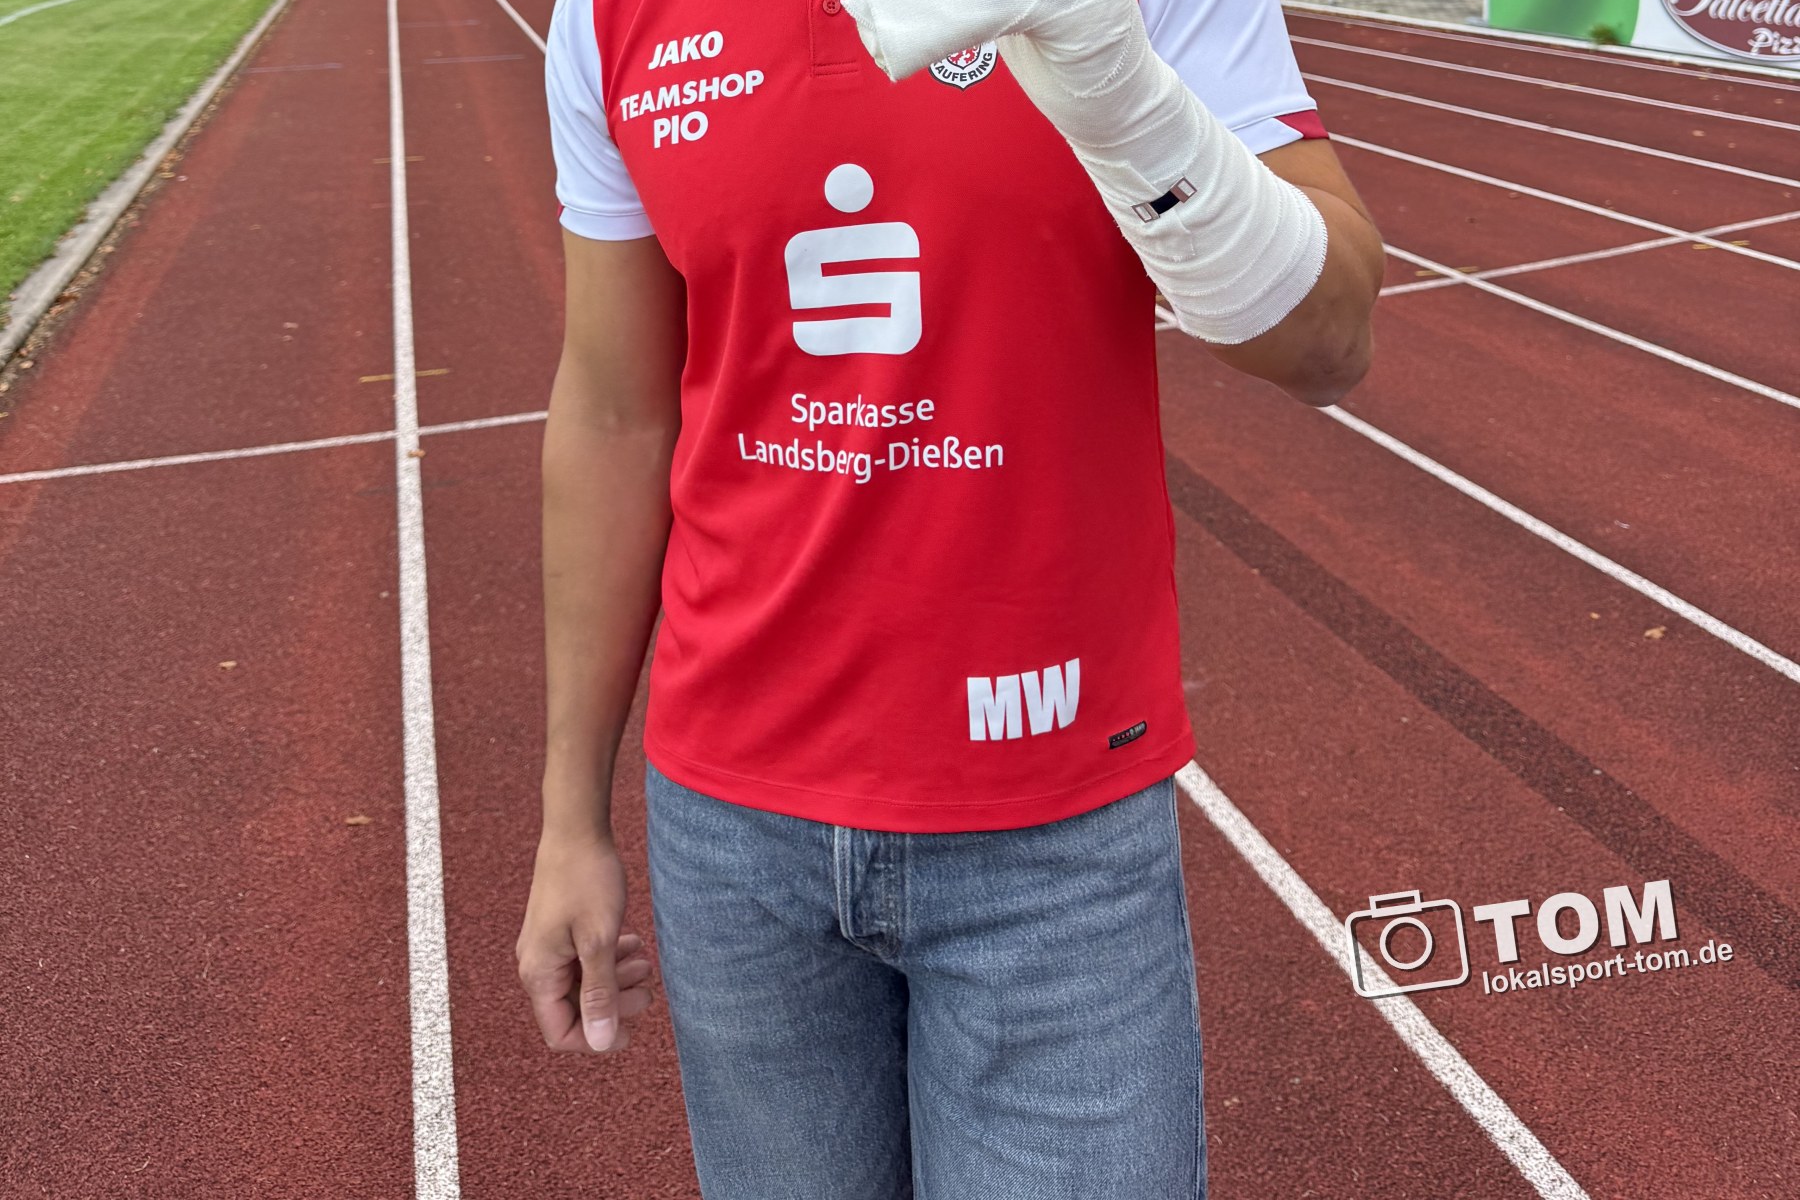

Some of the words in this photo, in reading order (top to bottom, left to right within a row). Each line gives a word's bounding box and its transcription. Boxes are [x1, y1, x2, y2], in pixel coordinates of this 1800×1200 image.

[648, 30, 724, 70] JAKO
[933, 52, 993, 82] AUFERING
[620, 69, 765, 122] TEAMSHOP
[653, 110, 709, 149] PIO
[790, 392, 935, 432] Sparkasse
[737, 432, 1004, 485] Landsberg-Dießen
[966, 657, 1081, 742] MW
